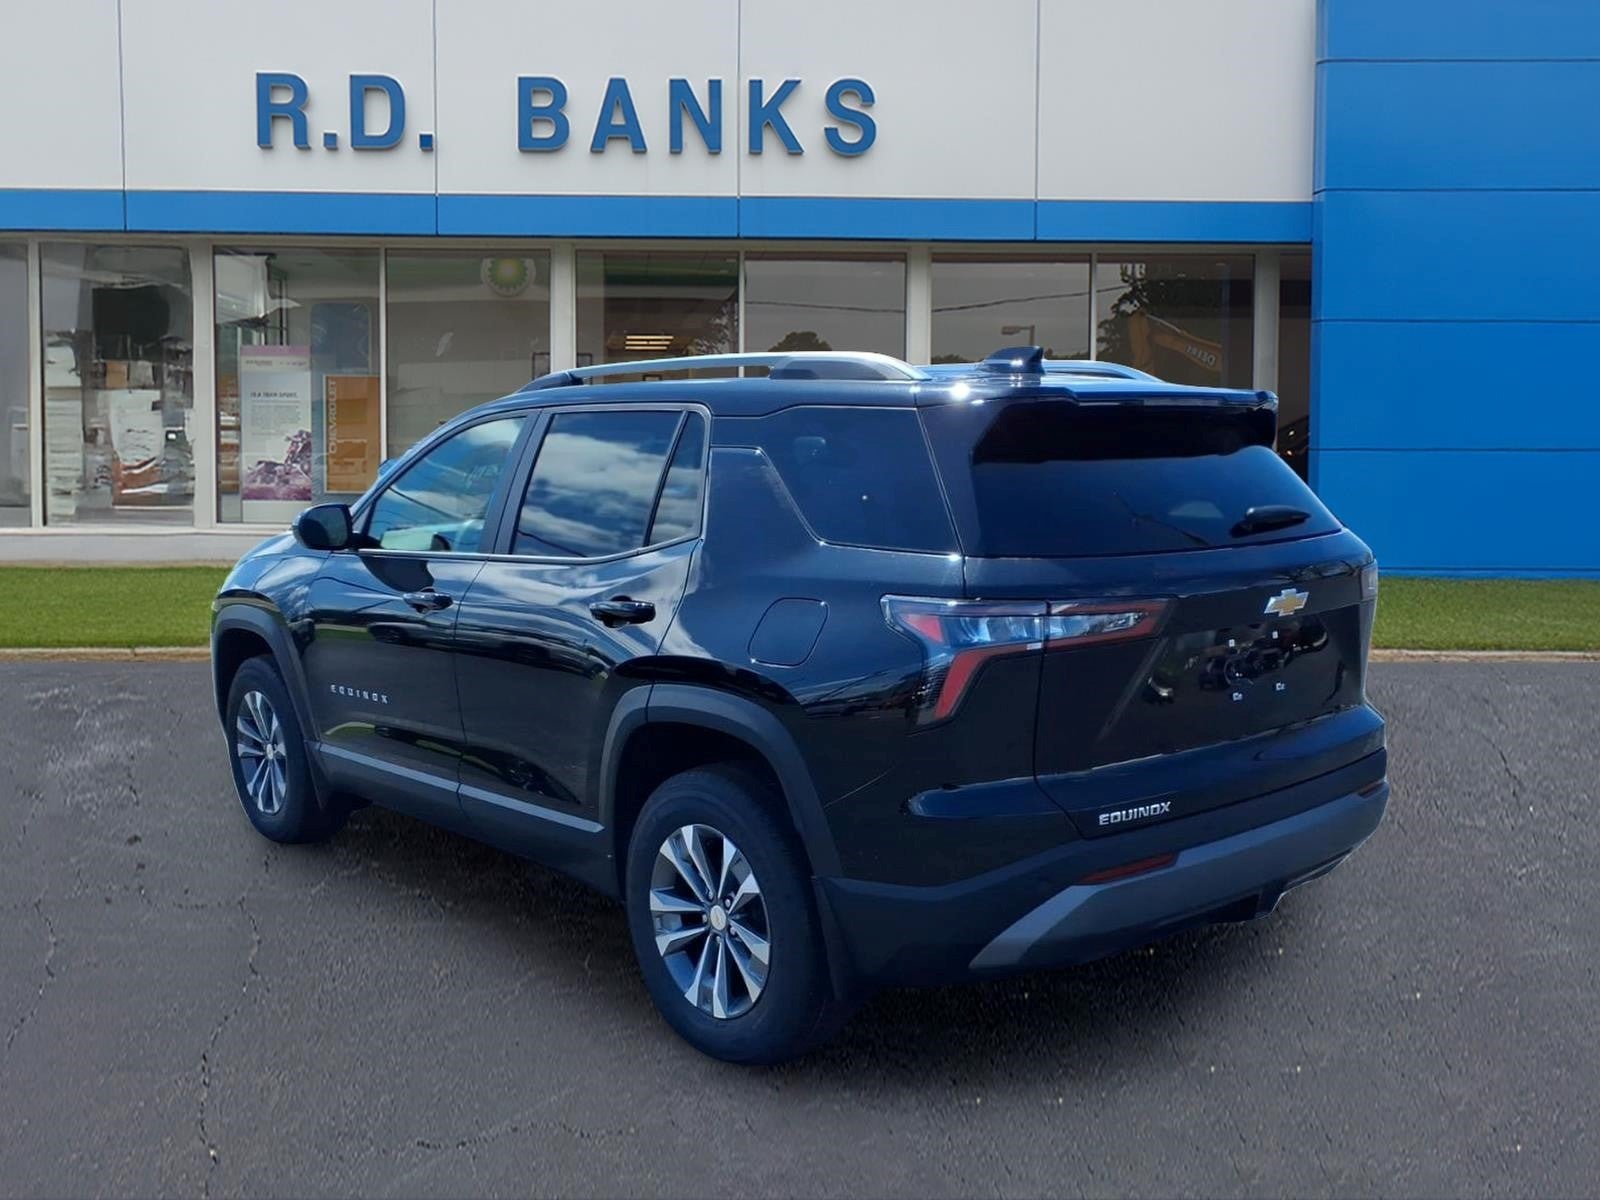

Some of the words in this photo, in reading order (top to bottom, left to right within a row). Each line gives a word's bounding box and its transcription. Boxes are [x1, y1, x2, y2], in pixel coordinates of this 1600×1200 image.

[256, 72, 434, 151] R.D.
[517, 76, 878, 157] BANKS
[330, 684, 388, 704] EQUINOX
[1099, 801, 1171, 825] EQUINOX
